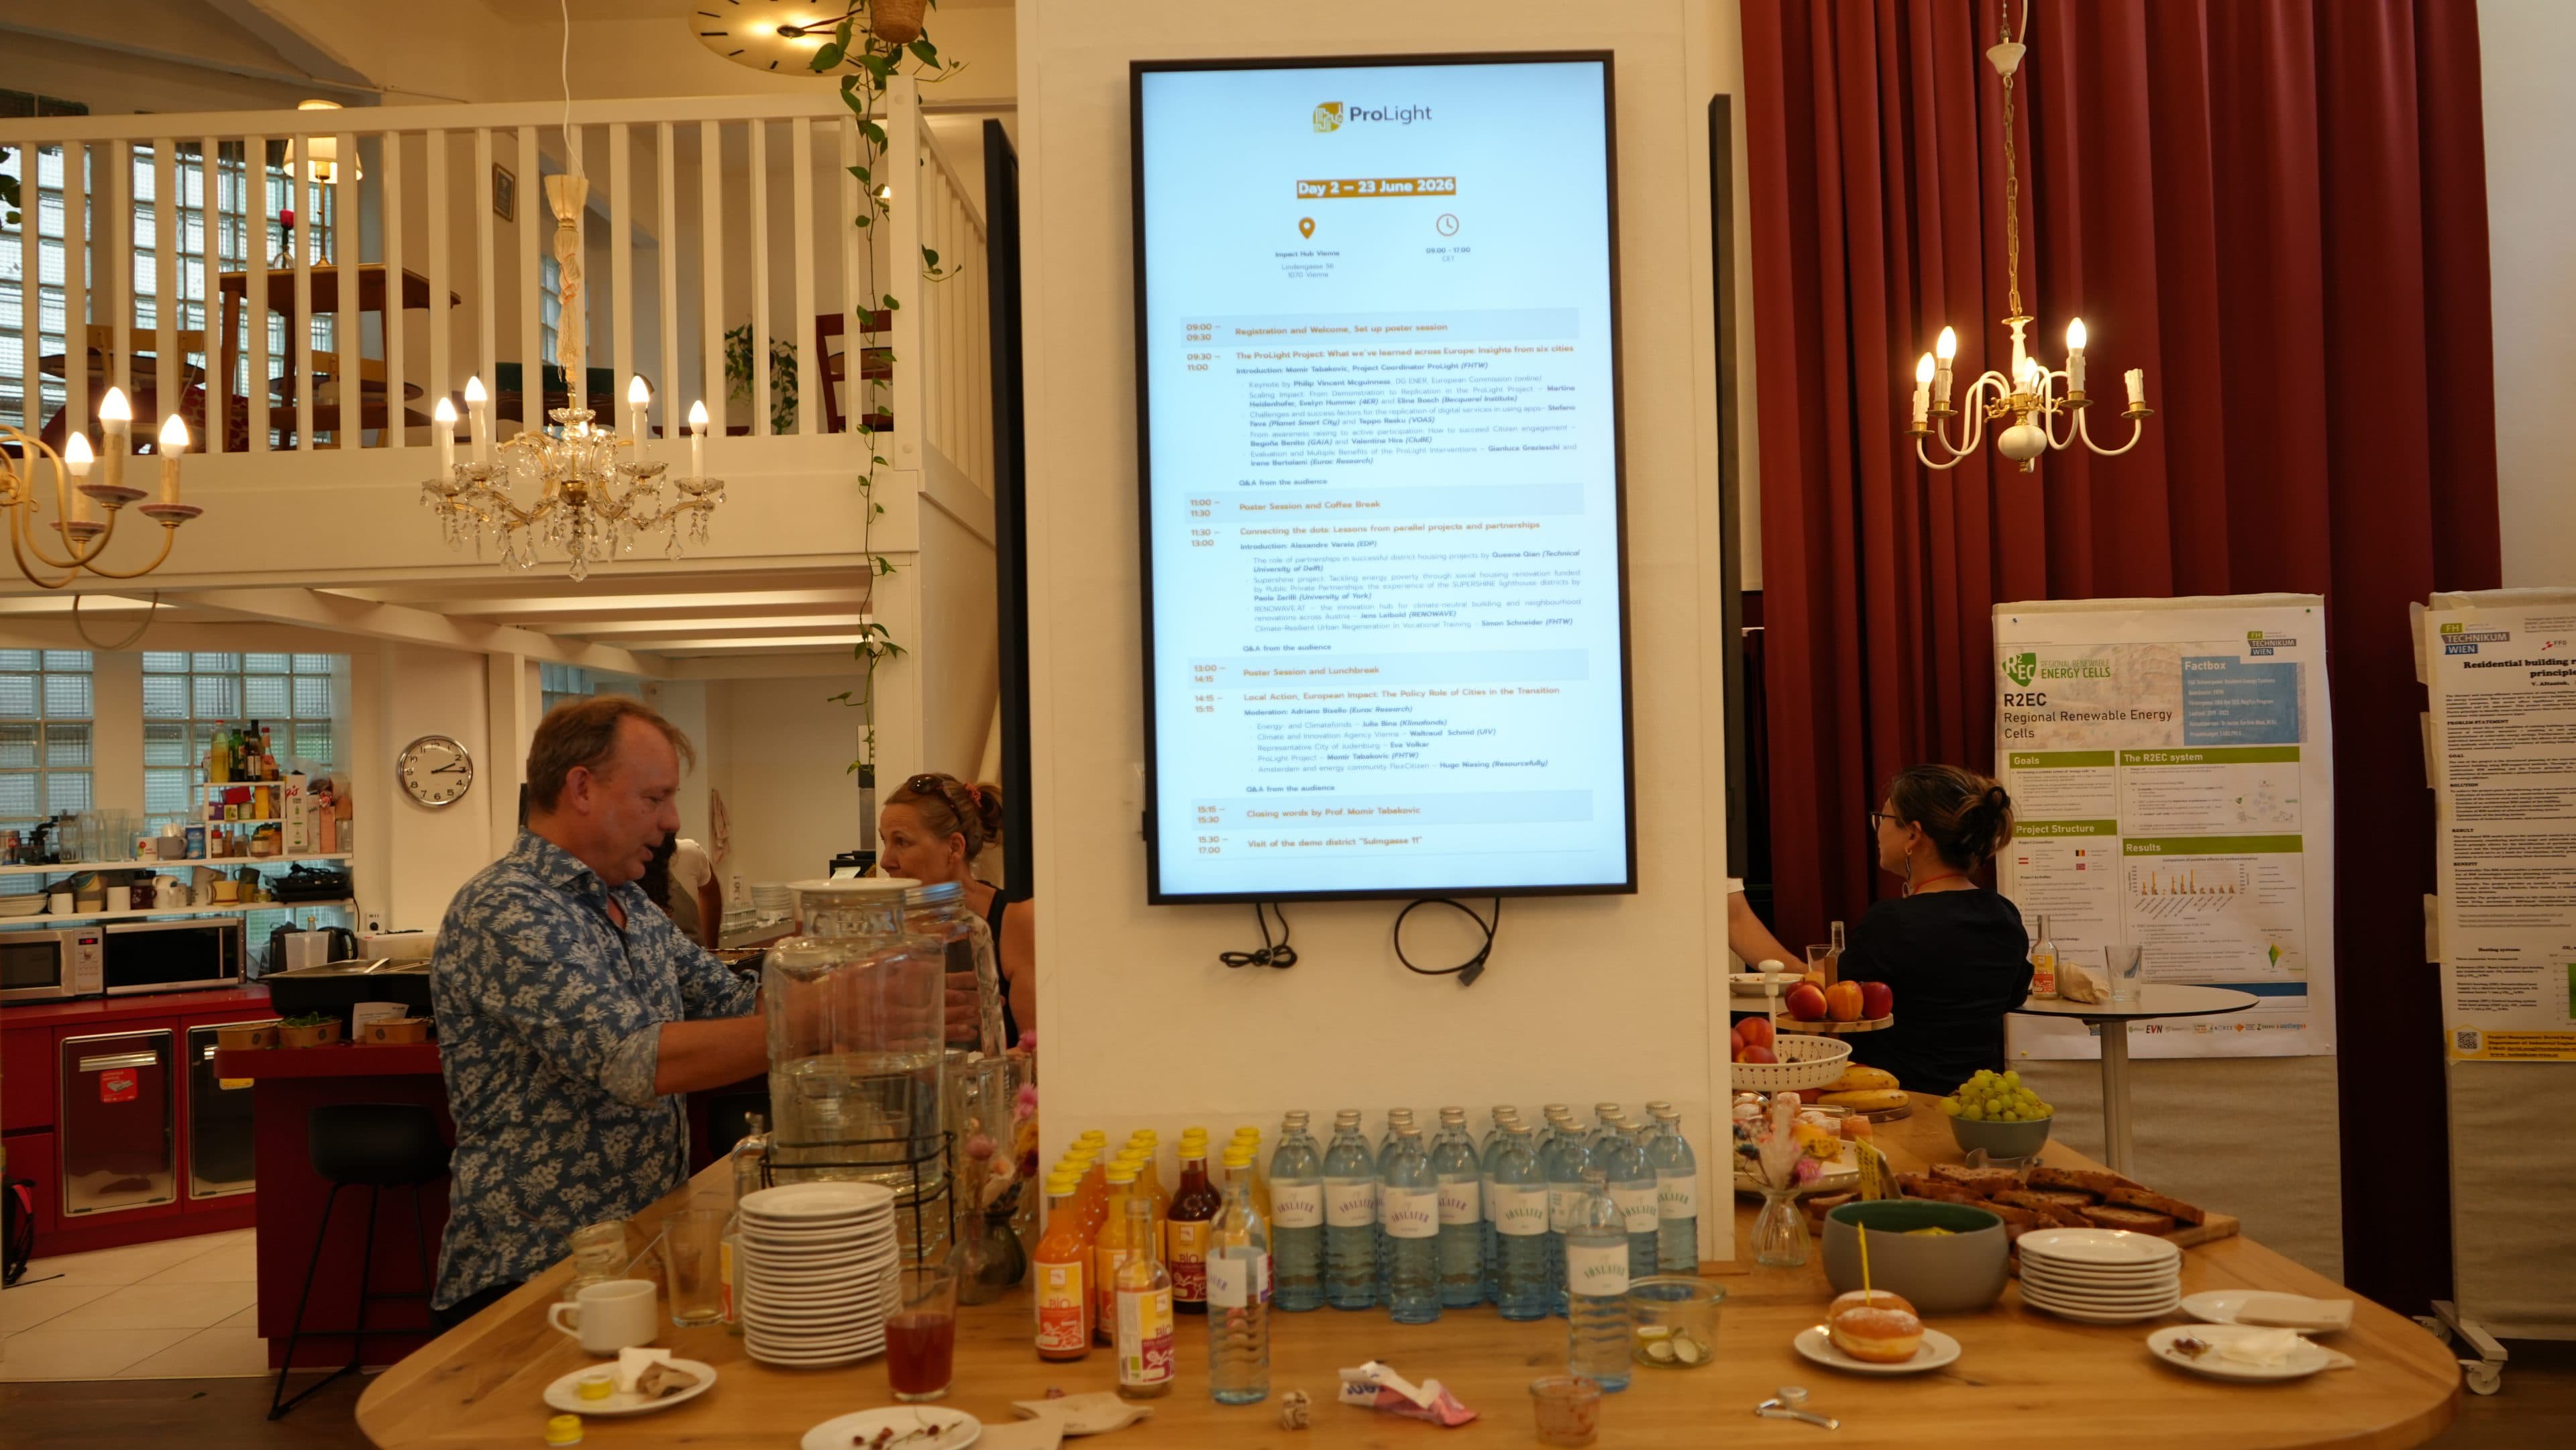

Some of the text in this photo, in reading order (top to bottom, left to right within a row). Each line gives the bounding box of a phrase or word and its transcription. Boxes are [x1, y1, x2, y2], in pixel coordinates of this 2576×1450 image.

[1350, 105, 1432, 125] ProLight
[1299, 182, 1326, 197] Day
[1330, 181, 1340, 194] 2
[1358, 180, 1375, 193] 23
[1380, 179, 1413, 193] June
[1417, 178, 1454, 191] 2026
[1281, 263, 1322, 271] Lindengasse
[1235, 327, 1287, 338] Registration
[1290, 326, 1307, 334] and
[1385, 325, 1413, 333] poster
[1415, 323, 1448, 331] session
[1186, 333, 1212, 342] 09:30
[1236, 352, 1252, 360] The
[1254, 351, 1291, 360] ProLight
[1327, 350, 1350, 358] What
[1478, 346, 1512, 356] Insights
[1305, 501, 1323, 510] and
[1324, 501, 1352, 509] Coffee
[1354, 500, 1381, 508] Break
[1240, 527, 1290, 537] Connecting
[1333, 525, 1367, 533] Lessons
[1393, 523, 1426, 533] parallel
[1428, 523, 1463, 532] projects
[1484, 521, 1540, 531] partnerships
[2446, 624, 2459, 632] FH
[2447, 633, 2508, 643] TECHNIKUM
[2448, 645, 2475, 654] WIEN
[2072, 659, 2110, 667] RENEWABLE
[2184, 662, 2226, 670] Factbox
[2463, 659, 2522, 668] Residential
[2525, 658, 2569, 667] building
[1243, 666, 1379, 677] Poster Session and Lunchbreak
[2041, 666, 2110, 679] ENERGY CELLS
[1303, 691, 1345, 701] European
[1399, 689, 1426, 698] Policy
[1489, 688, 1497, 696] in
[1517, 686, 1560, 694] Transition
[2004, 693, 2047, 707] R2EC
[2004, 709, 2172, 725] Regional Renewable Energy
[2004, 729, 2035, 738] Cells
[2014, 757, 2039, 765] Goals
[2124, 753, 2203, 764] The R2EC system
[421, 790, 427, 798] 7
[1246, 809, 1279, 820] Closing
[1311, 809, 1323, 817] by
[1346, 807, 1374, 815] Momir
[1377, 806, 1420, 815] Tabakovic
[2016, 824, 2094, 835] Project Structure
[1248, 840, 1267, 848] Visit
[1298, 839, 1324, 847] demo
[1326, 838, 1356, 846] district
[2127, 844, 2161, 852] Results
[1198, 846, 1221, 854] 17.00
[2146, 1025, 2163, 1034] EVN
